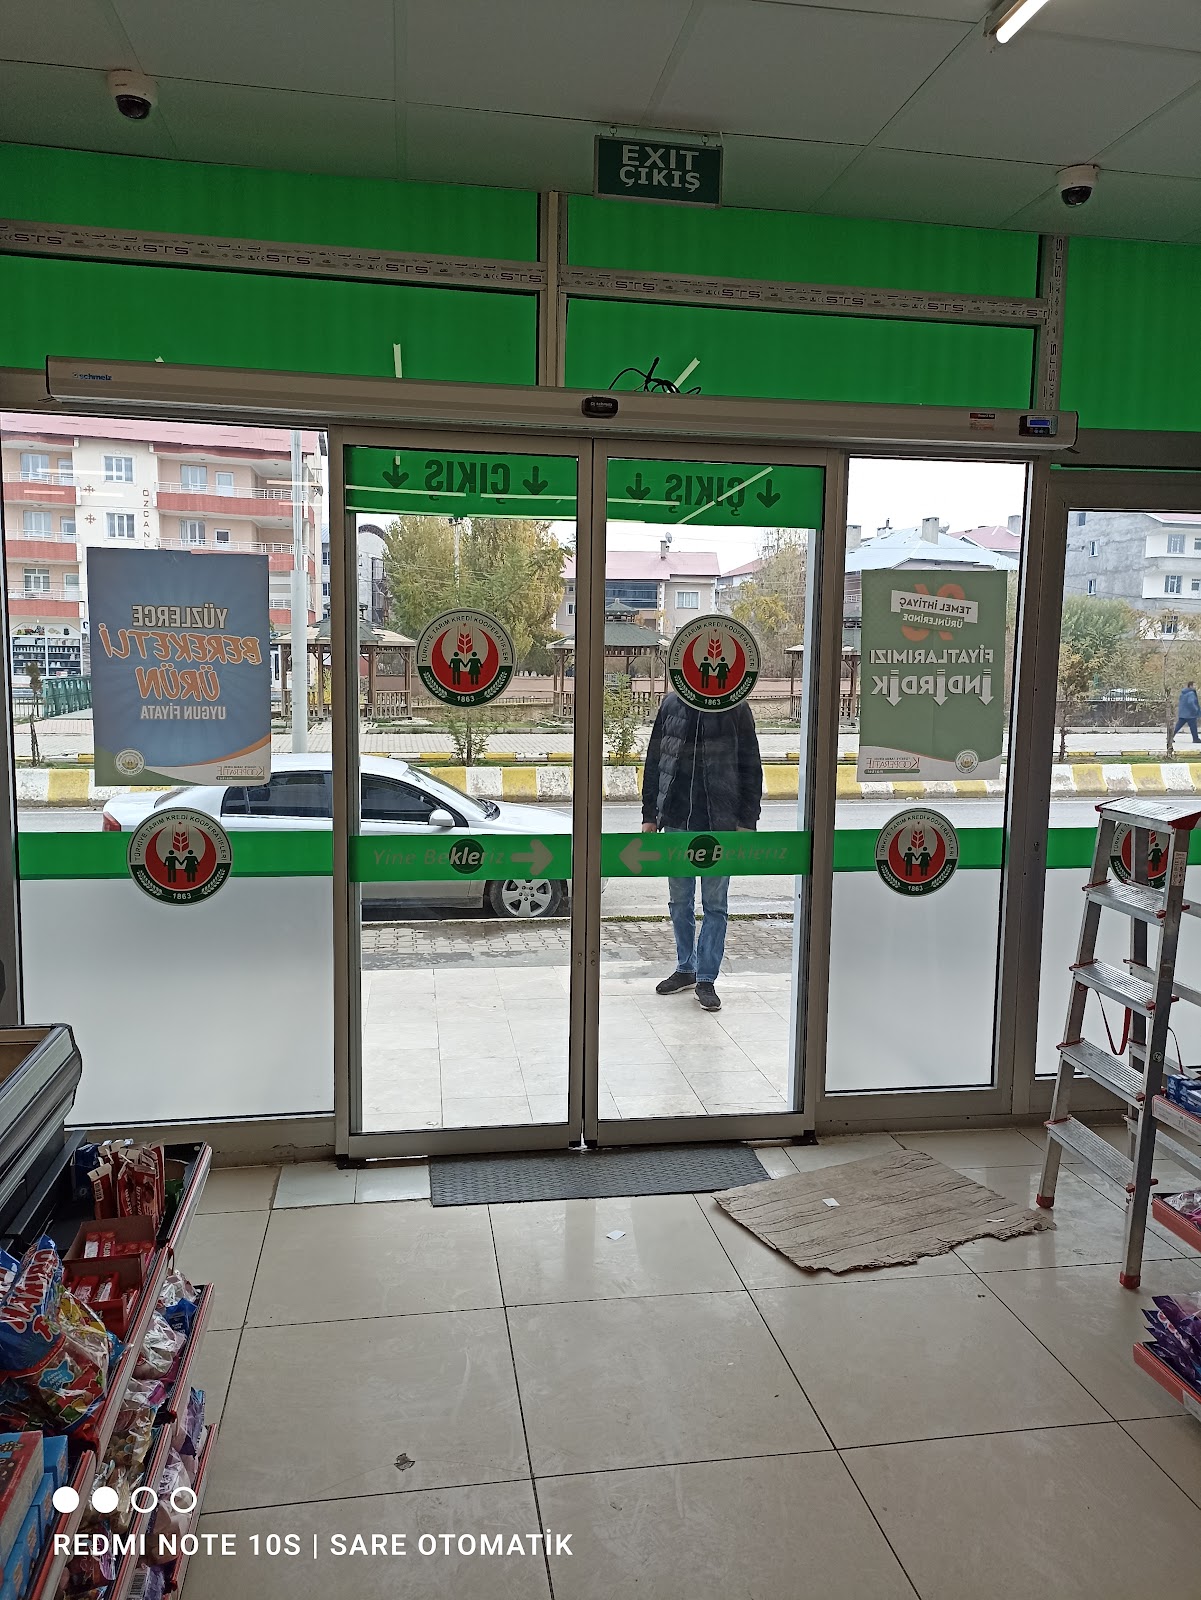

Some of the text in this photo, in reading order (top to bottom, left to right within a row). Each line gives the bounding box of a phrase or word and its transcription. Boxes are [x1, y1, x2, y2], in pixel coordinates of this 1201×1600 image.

[622, 145, 700, 170] EXIT
[620, 166, 701, 193] ÇIKIŞ
[14, 233, 542, 283] STS STS STS STS STS
[615, 280, 1047, 318] STS STS STS STS ST
[373, 847, 505, 865] Yine Bekleriz
[172, 892, 192, 900] 1863
